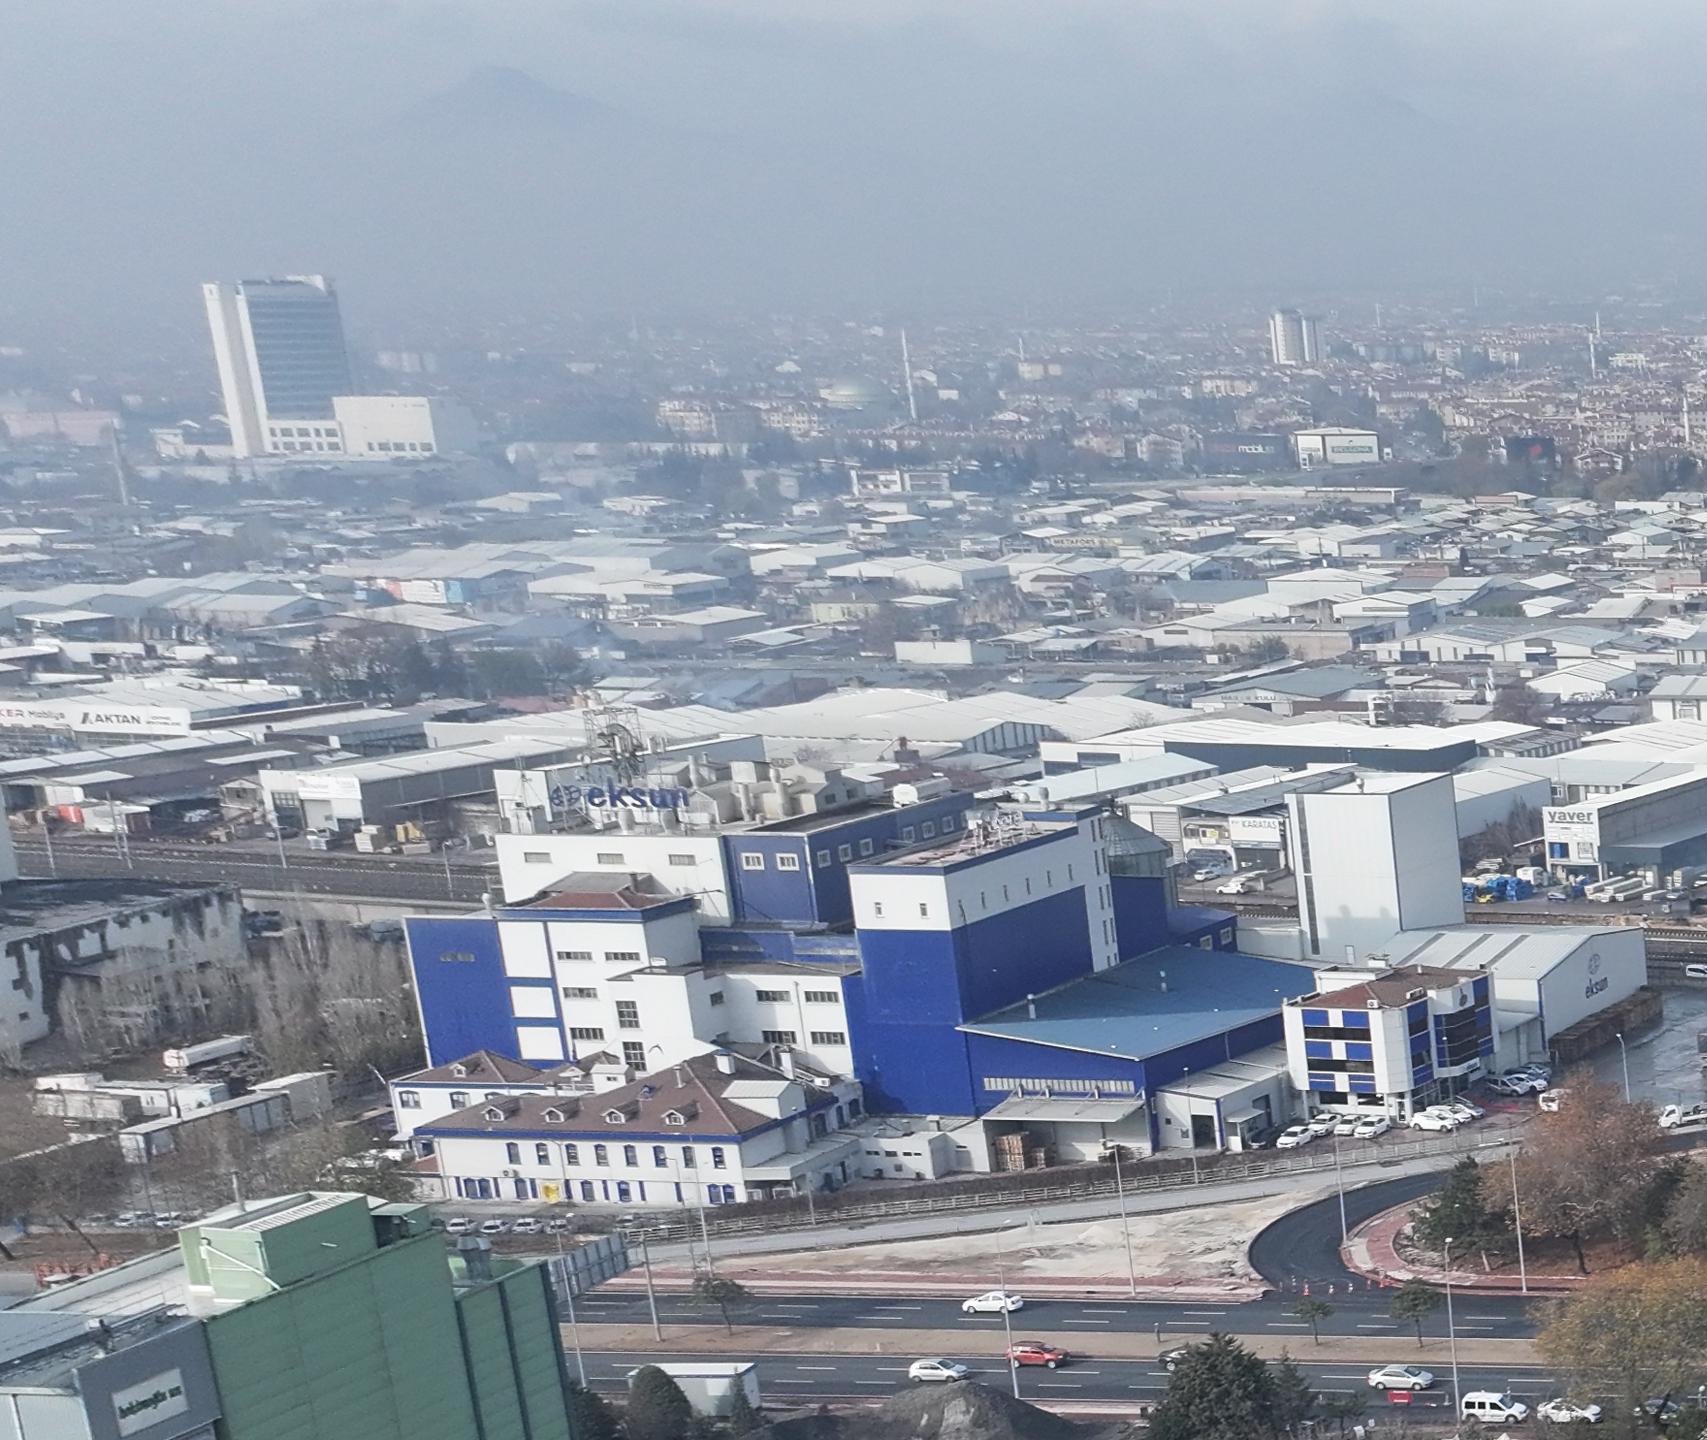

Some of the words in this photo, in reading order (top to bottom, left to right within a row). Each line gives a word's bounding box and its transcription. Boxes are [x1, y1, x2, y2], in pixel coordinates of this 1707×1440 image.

[95, 714, 142, 725] AKTAN
[587, 775, 689, 808] eksun
[1548, 811, 1593, 822] yaver
